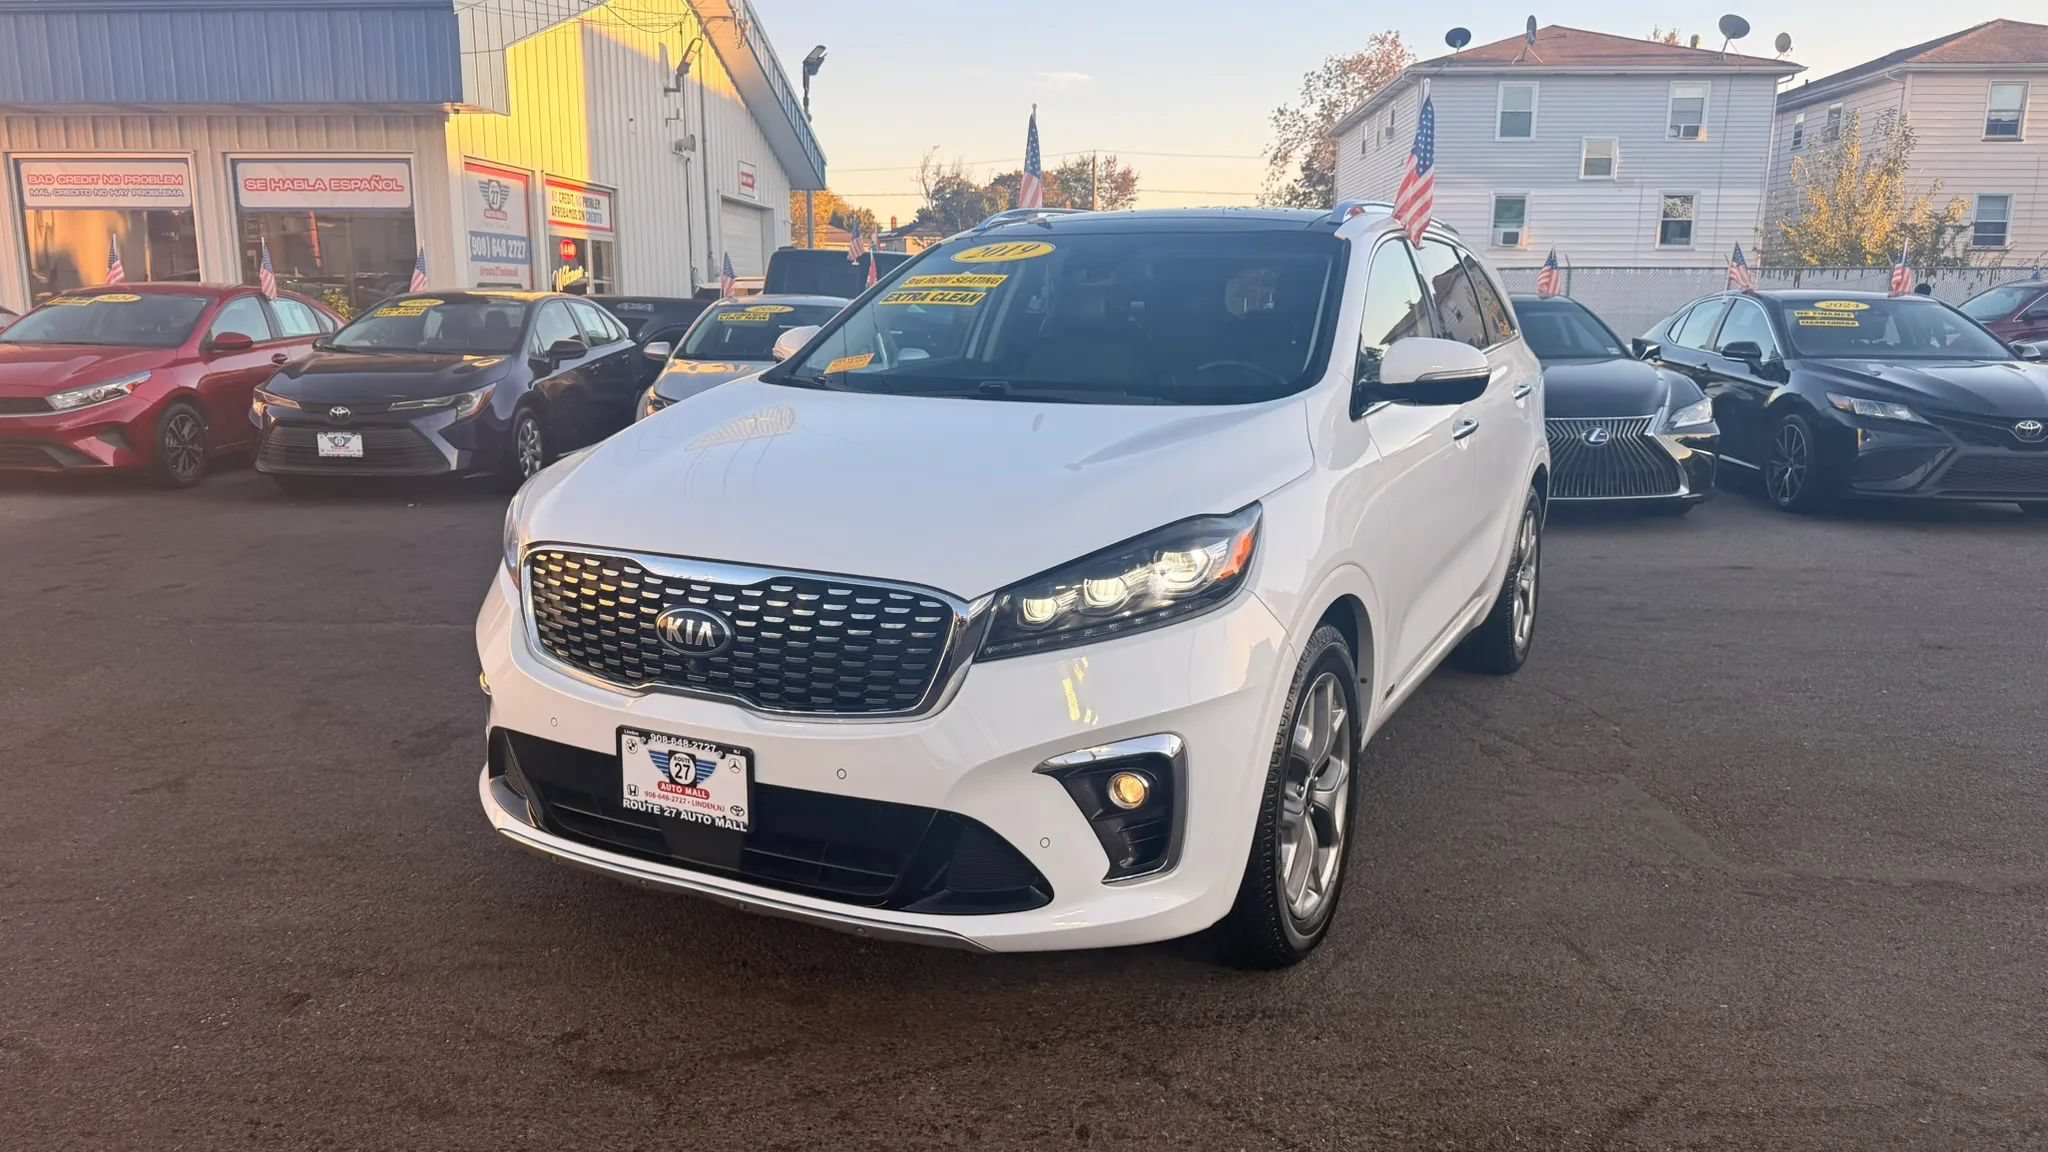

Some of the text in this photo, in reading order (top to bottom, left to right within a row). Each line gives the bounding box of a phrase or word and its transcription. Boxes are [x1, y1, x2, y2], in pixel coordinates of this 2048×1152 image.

[27, 174, 183, 185] BAD CREDIT NO PROBLEM
[244, 175, 404, 192] SE HABLA ESPAÑOL
[29, 188, 184, 197] MAL CREDITO NO HAY PROBLEMA
[490, 190, 499, 205] 27
[508, 239, 526, 260] 2727
[963, 243, 1042, 260] 2019
[951, 276, 1002, 285] SEATING
[884, 292, 982, 303] EXTRA CLEAN
[666, 616, 716, 647] KIA
[650, 733, 717, 752] 908-648-2727
[673, 756, 690, 764] ROUTE
[674, 762, 690, 780] 27
[660, 782, 708, 799] AUTO MALL
[623, 798, 748, 832] ROUTE 27 AUTO MALL
